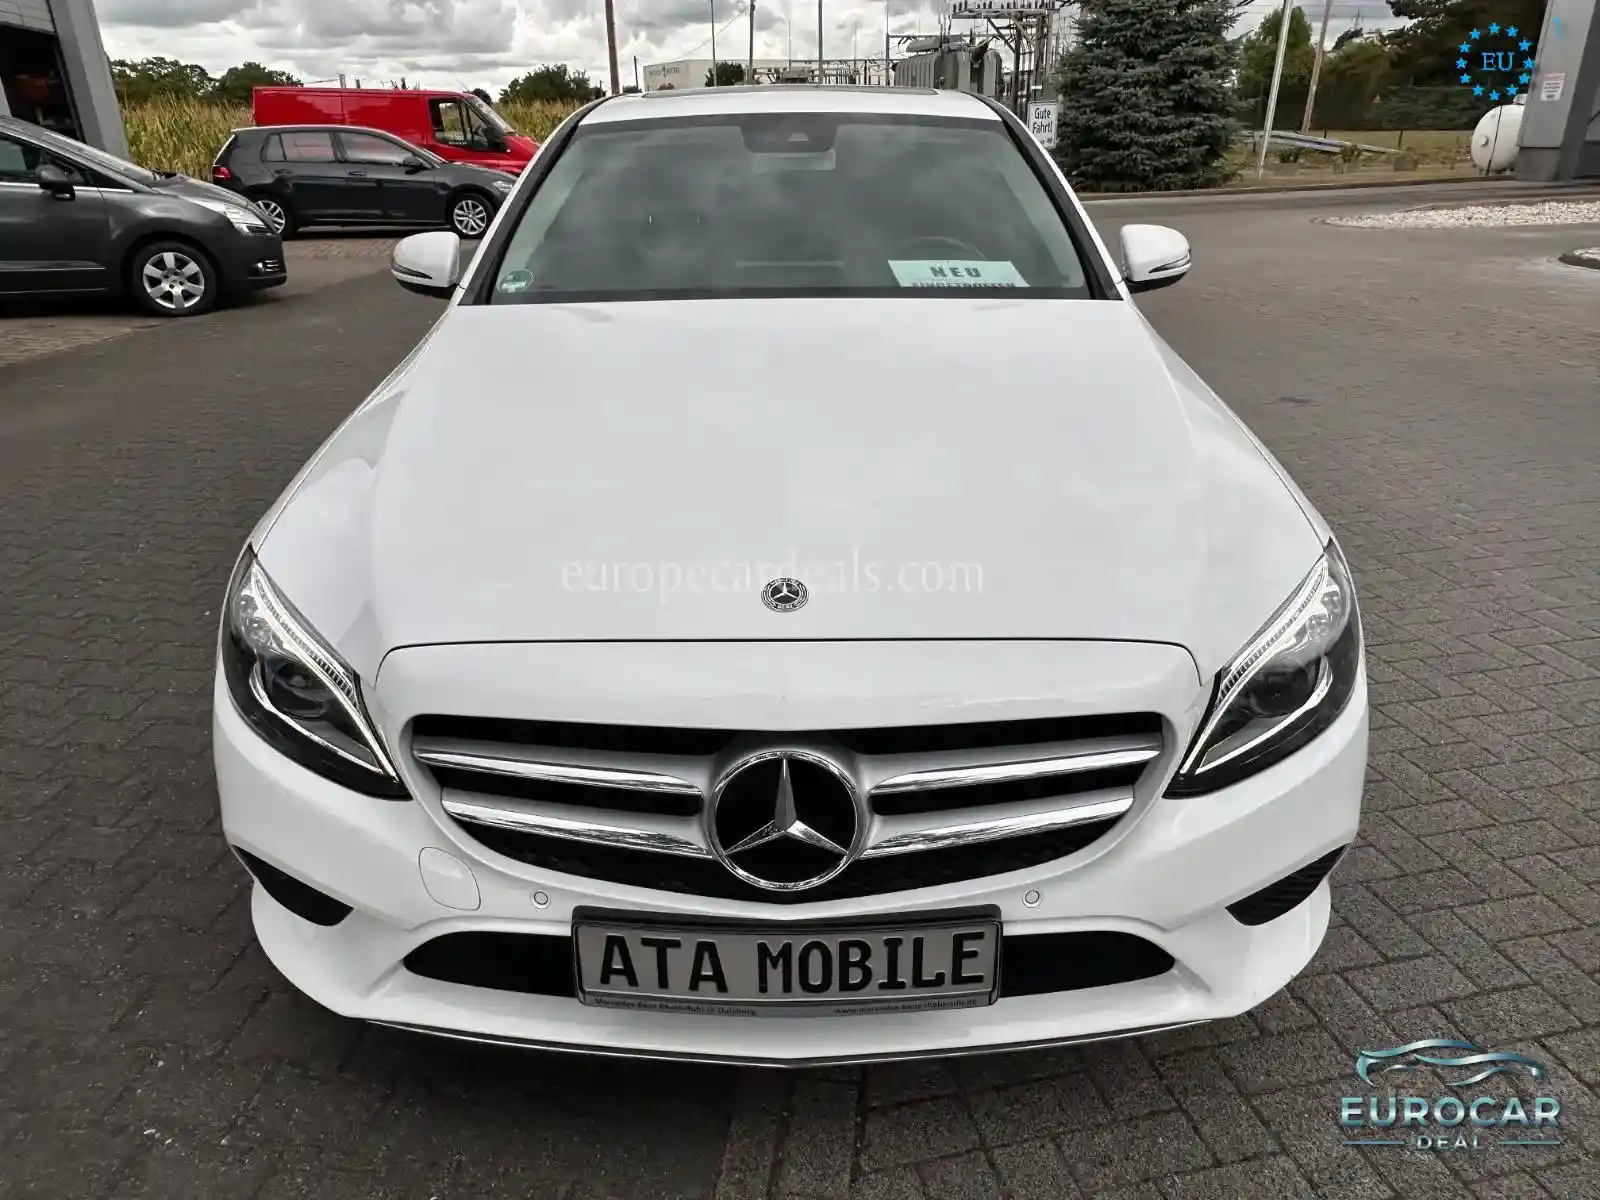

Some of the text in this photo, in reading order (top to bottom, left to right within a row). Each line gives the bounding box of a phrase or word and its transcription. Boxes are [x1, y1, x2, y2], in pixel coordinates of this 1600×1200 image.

[1034, 107, 1051, 120] Gute
[929, 266, 982, 278] NEU
[599, 931, 985, 994] ATA MOBILE
